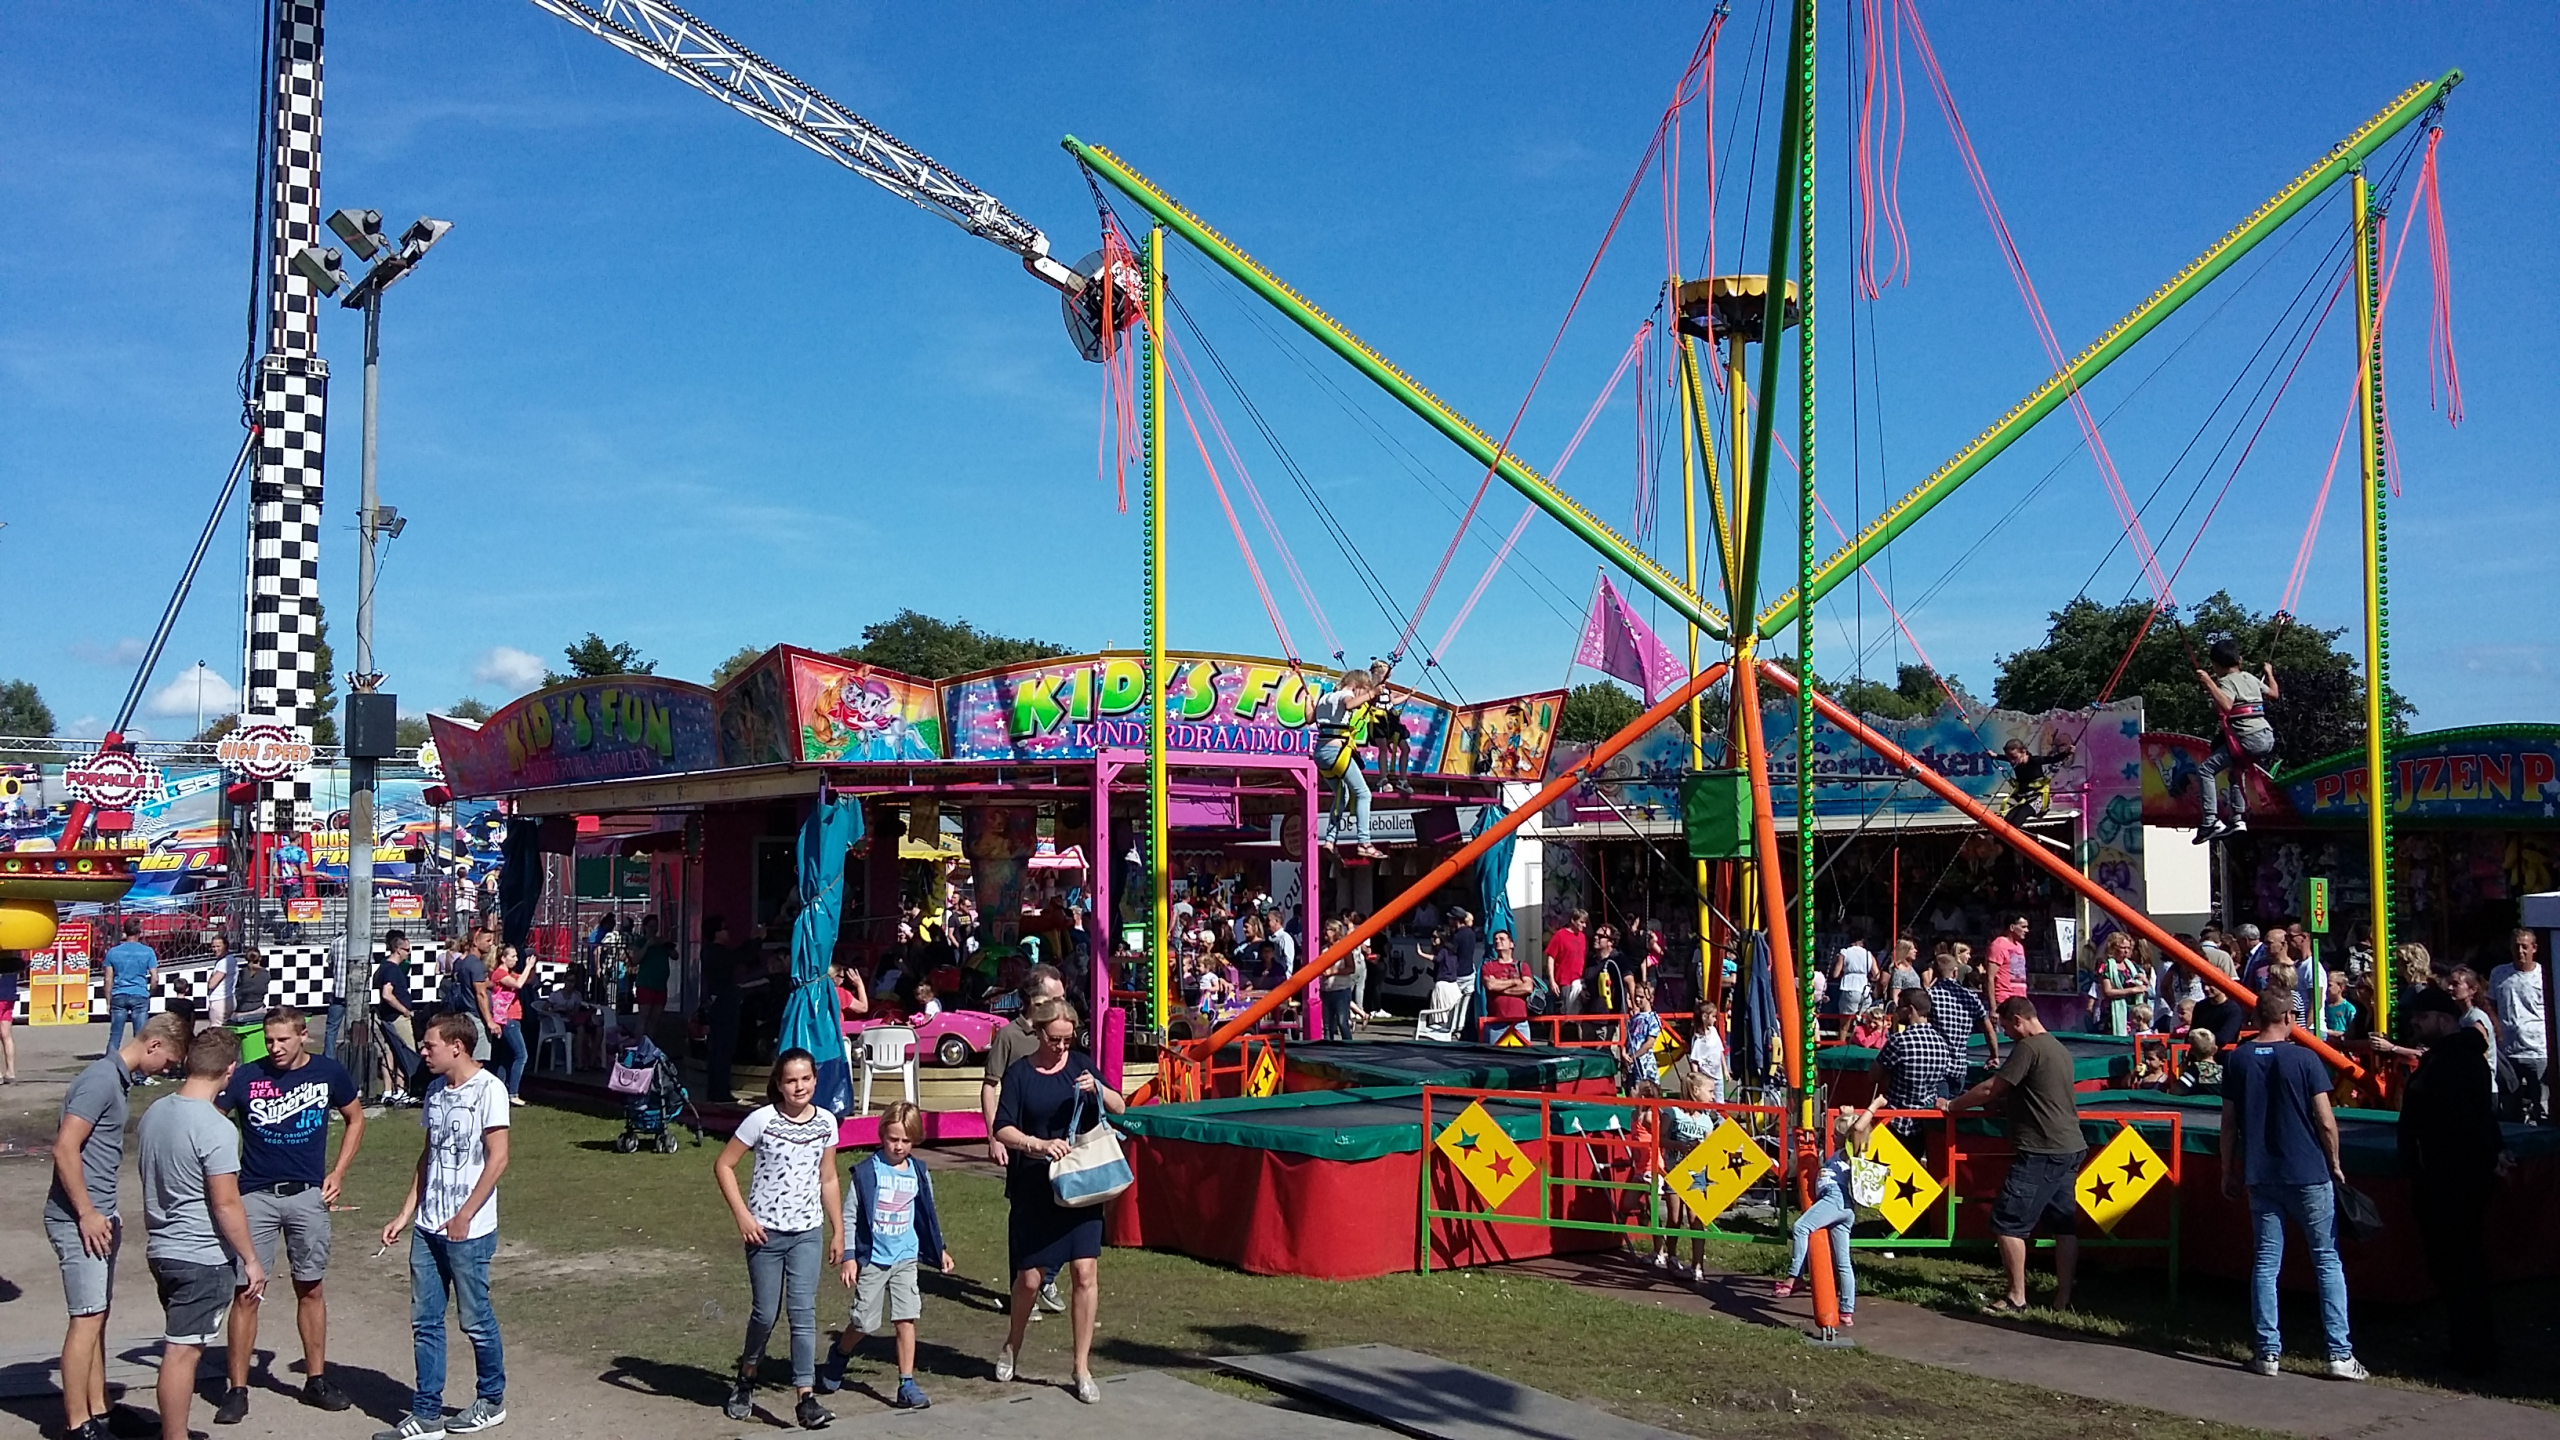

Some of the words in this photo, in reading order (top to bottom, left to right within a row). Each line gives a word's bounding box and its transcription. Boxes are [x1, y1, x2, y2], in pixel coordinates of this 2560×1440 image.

[504, 693, 595, 773] KID'S
[602, 689, 675, 760] FUN
[219, 741, 258, 760] HIGH
[262, 743, 312, 762] SPEED
[65, 769, 147, 788] FORMULA
[151, 774, 160, 790] 1
[2313, 754, 2513, 812] PRJZEN
[249, 1081, 272, 1089] THE
[249, 1088, 283, 1099] REAL
[248, 1083, 329, 1127] Superdry
[295, 1109, 325, 1129] JPN
[283, 1127, 316, 1139] ORIGINAL
